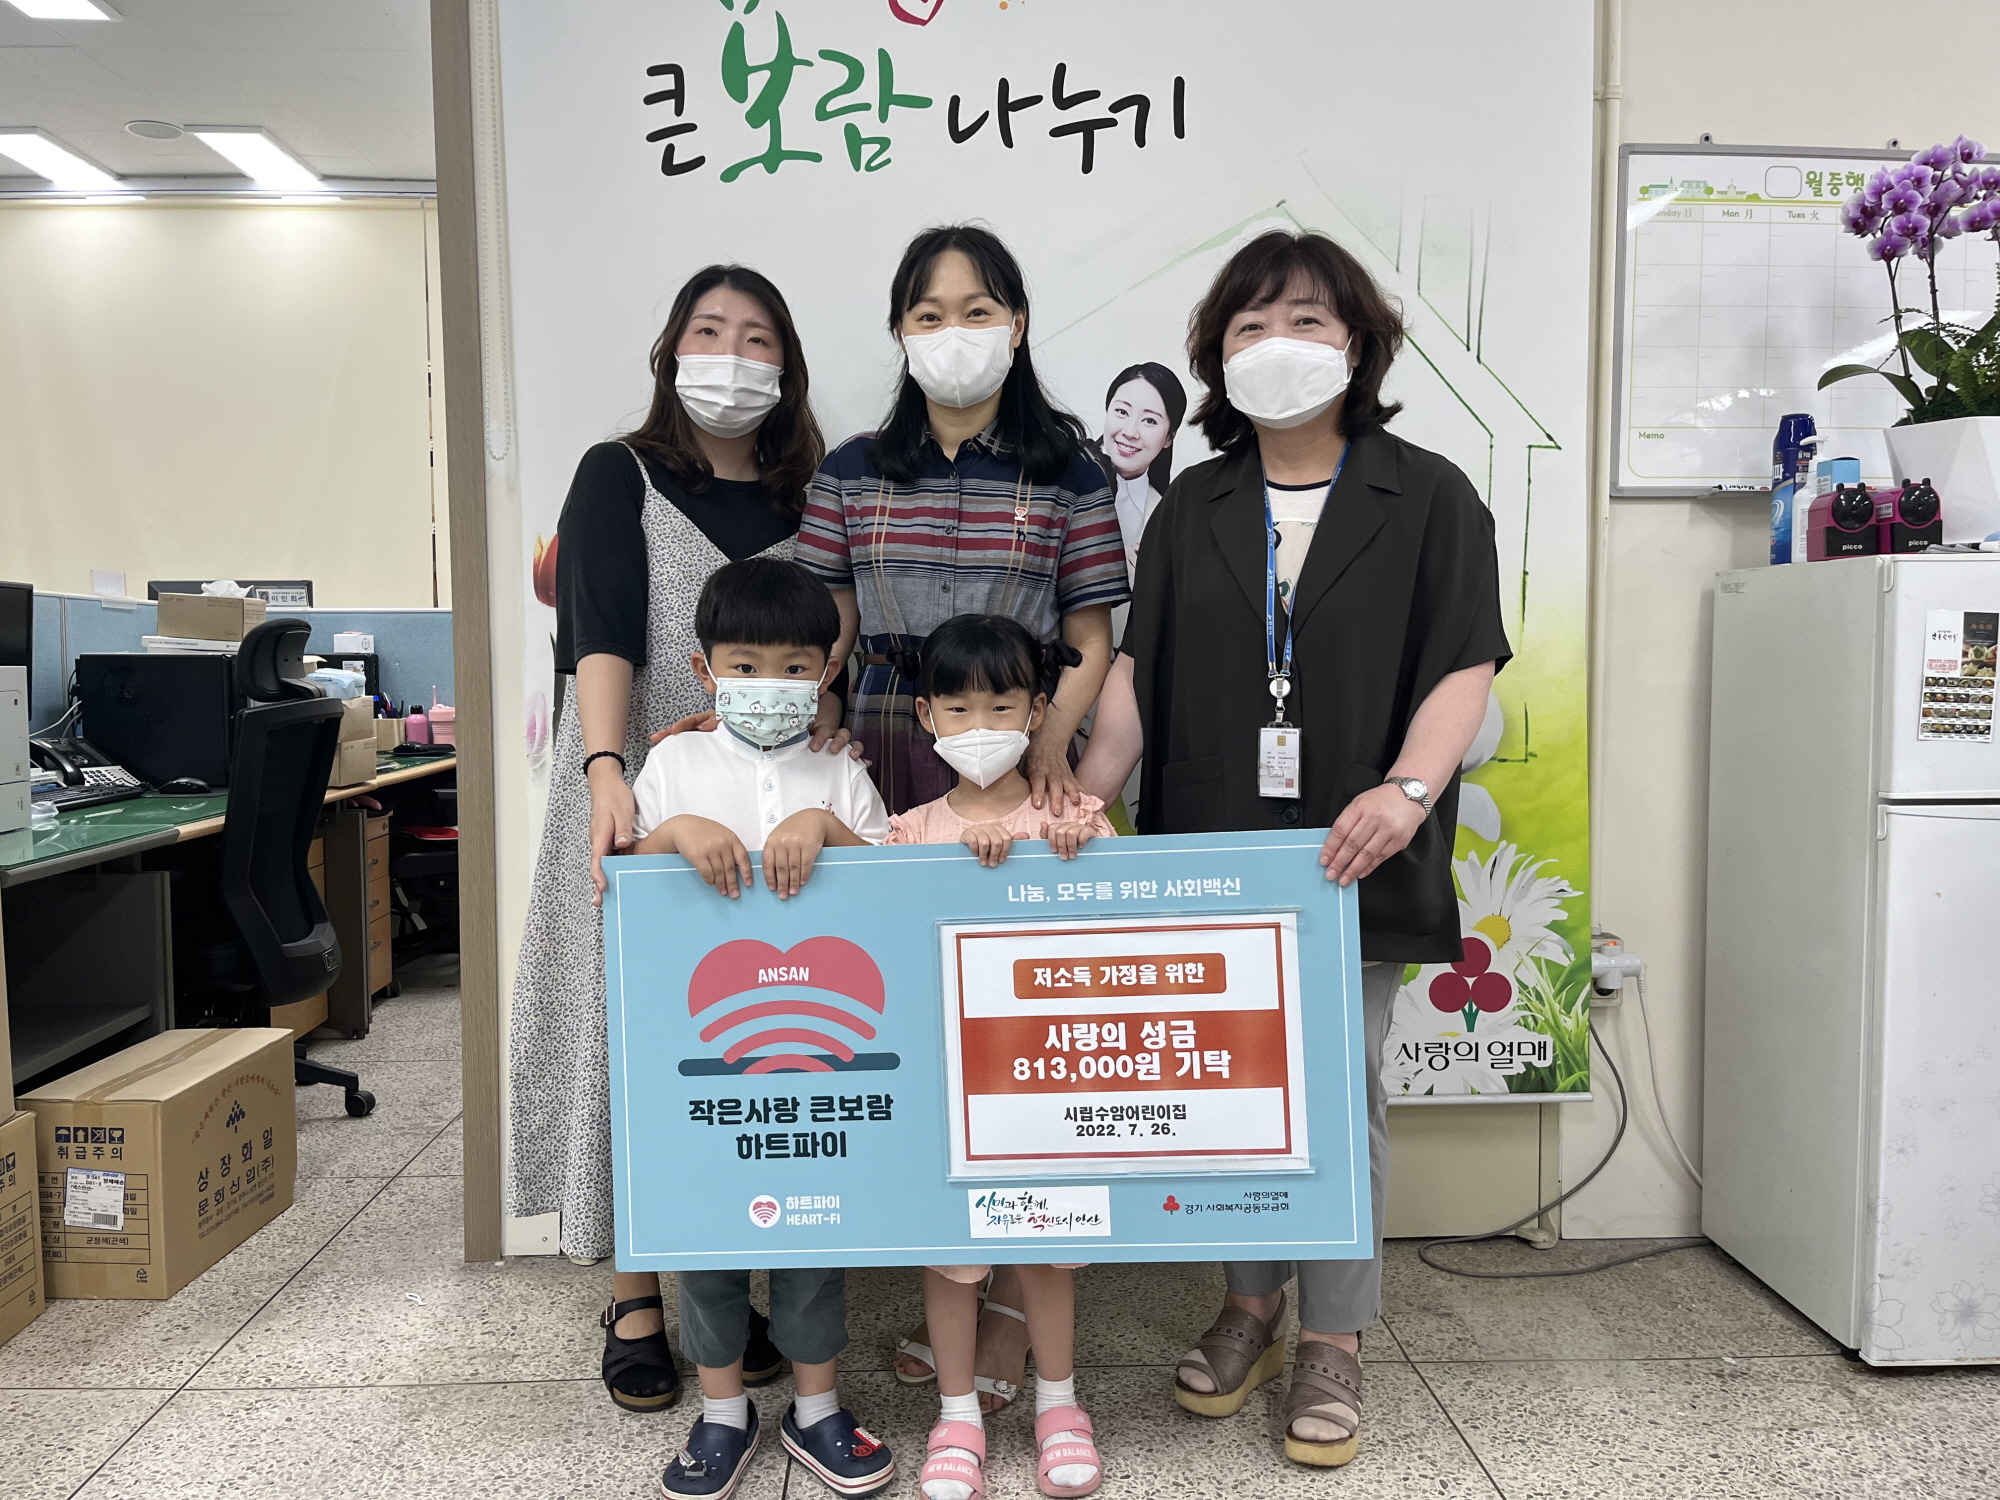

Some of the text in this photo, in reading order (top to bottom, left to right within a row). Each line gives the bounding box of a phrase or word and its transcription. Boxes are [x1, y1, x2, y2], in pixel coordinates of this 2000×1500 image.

[643, 10, 1186, 184] 큰 보람 나누기
[1805, 170, 1873, 198] 월중행
[1655, 208, 1682, 219] unday
[1722, 208, 1753, 220] Mon 月
[1787, 209, 1819, 221] Tues 火
[1638, 431, 1665, 440] Memo
[1842, 543, 1863, 552] picco
[1908, 539, 1929, 547] picco
[1007, 877, 1241, 904] 나눔, 모두를 위한 사회백신
[757, 966, 810, 984] ANSAN
[1033, 961, 1205, 989] 저소득 가정을 위한
[1044, 1019, 1197, 1053] 사랑의 성금
[1394, 1040, 1548, 1072] 사랑의 열매
[1012, 1050, 1232, 1082] 813,000원 기탁
[688, 1093, 894, 1126] 작은사랑 큰보람
[1063, 1104, 1188, 1123] 시립수암어린이집
[1076, 1122, 1177, 1138] 2022. 7. 26.
[735, 1130, 848, 1160] 하트파이
[785, 1195, 841, 1211] 하트파이
[1242, 1191, 1289, 1202] 사랑의열매
[1184, 1202, 1290, 1215] 경기 사회복지공동모금회
[786, 1212, 841, 1226] HEART-FI
[1075, 1214, 1104, 1226] 안산
[1046, 1447, 1093, 1462] NEW BALANCE
[927, 1462, 975, 1478] NEW BALANCE
